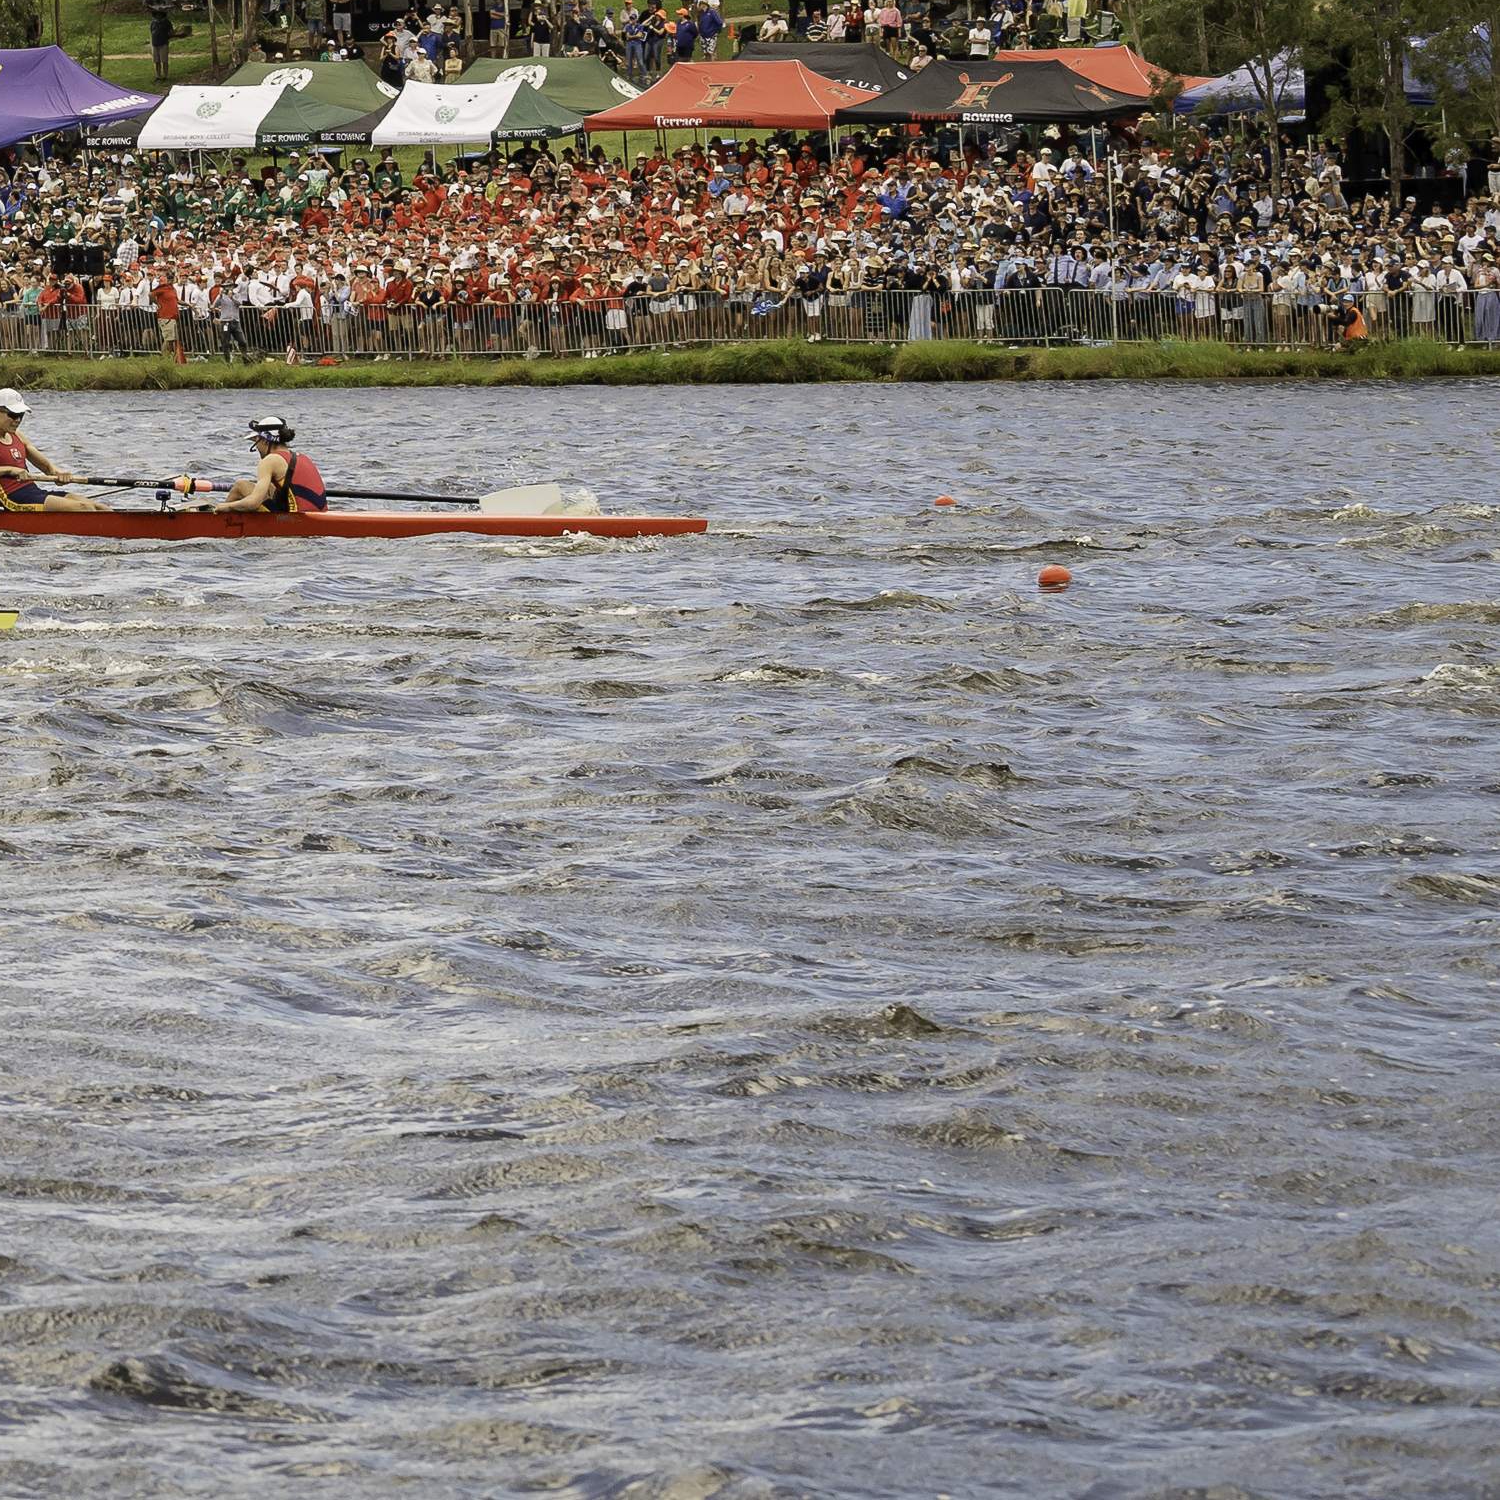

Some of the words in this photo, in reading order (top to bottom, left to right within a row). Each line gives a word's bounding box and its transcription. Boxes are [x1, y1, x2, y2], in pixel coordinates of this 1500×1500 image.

[833, 79, 882, 92] TUS
[81, 95, 149, 114] ROWING
[654, 115, 703, 128] Terrace
[962, 112, 1013, 122] ROWING
[262, 134, 276, 143] BBC
[278, 133, 309, 142] ROWING
[320, 133, 334, 141] BBC
[336, 133, 366, 141] ROWING
[497, 130, 512, 138] BBC
[513, 129, 546, 138] ROWING
[87, 137, 100, 146] BBC
[102, 137, 131, 146] ROWING
